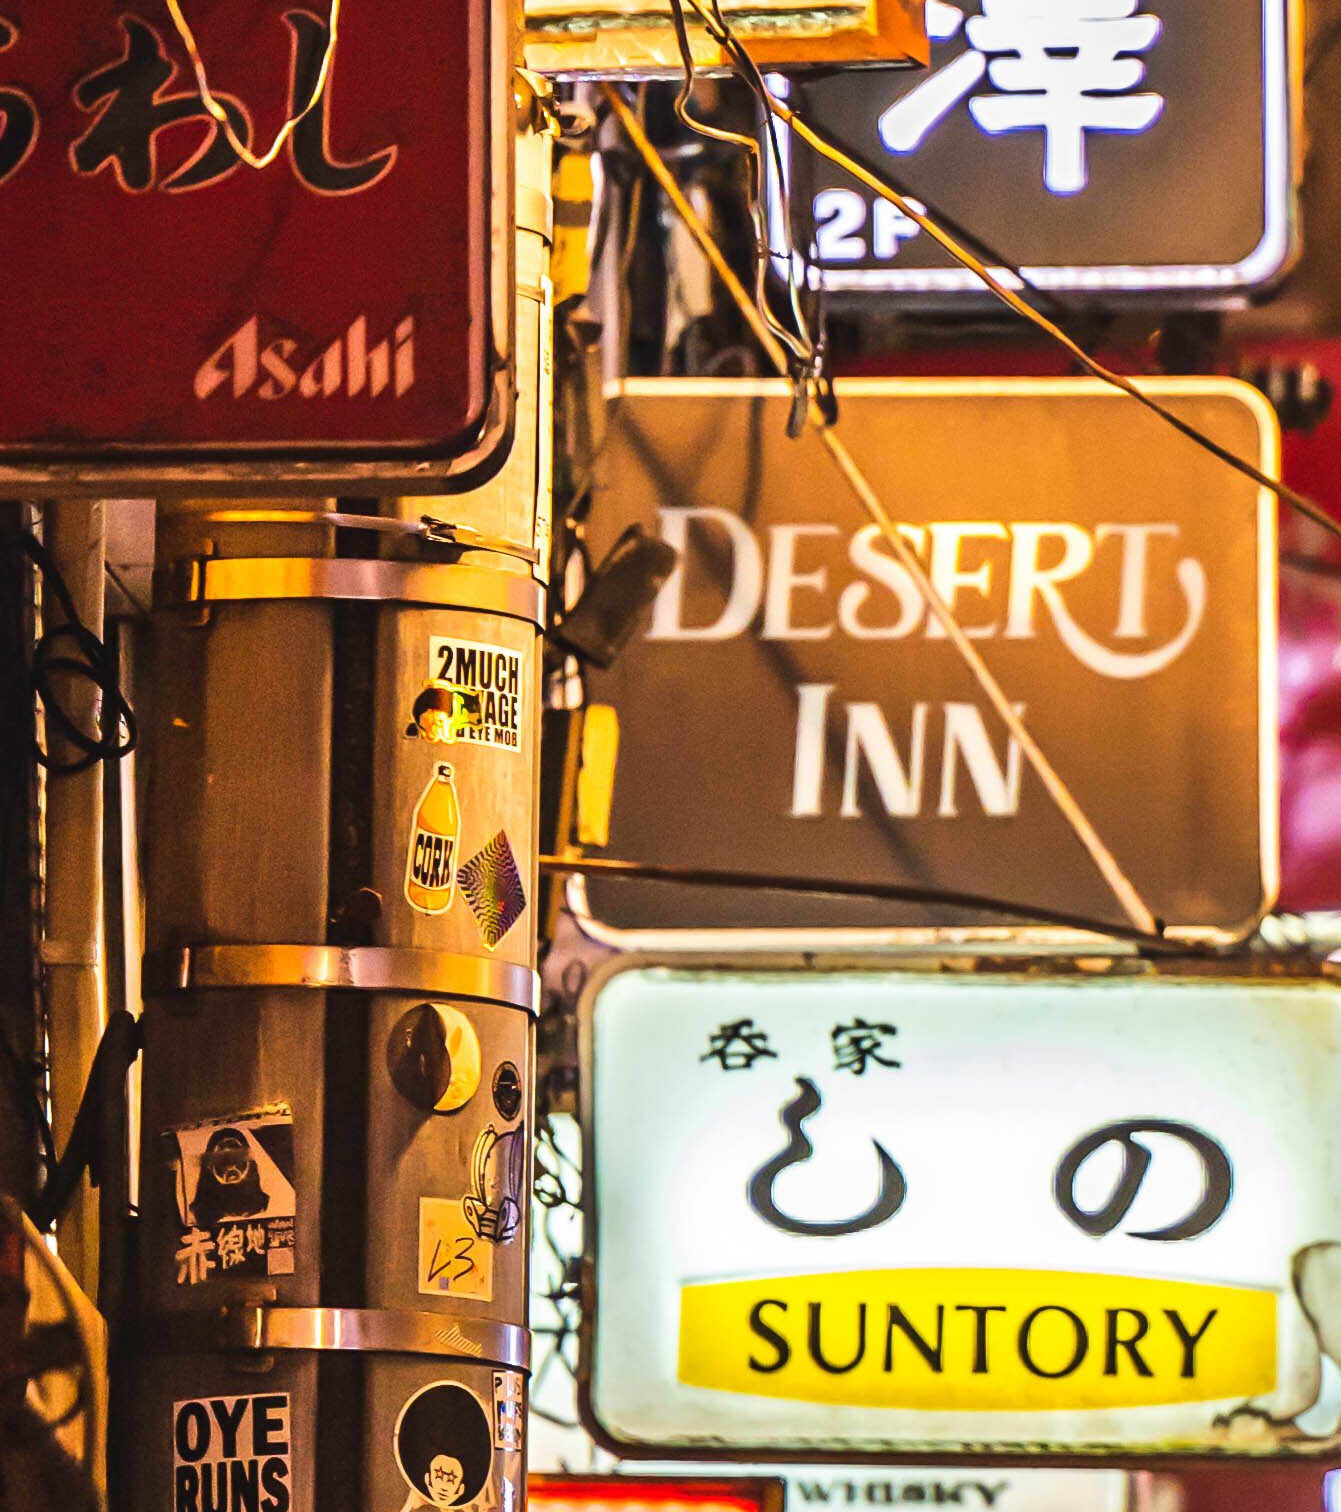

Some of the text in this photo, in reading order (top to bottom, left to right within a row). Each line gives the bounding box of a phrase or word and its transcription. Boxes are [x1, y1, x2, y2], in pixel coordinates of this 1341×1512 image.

[813, 187, 927, 262] 2F
[193, 315, 415, 400] Asahi
[643, 504, 1207, 680] DESERT
[437, 645, 519, 695] 2MUCH
[788, 682, 1026, 818] INN
[747, 1300, 1219, 1380] SUNTORY
[176, 1395, 289, 1463] OYE
